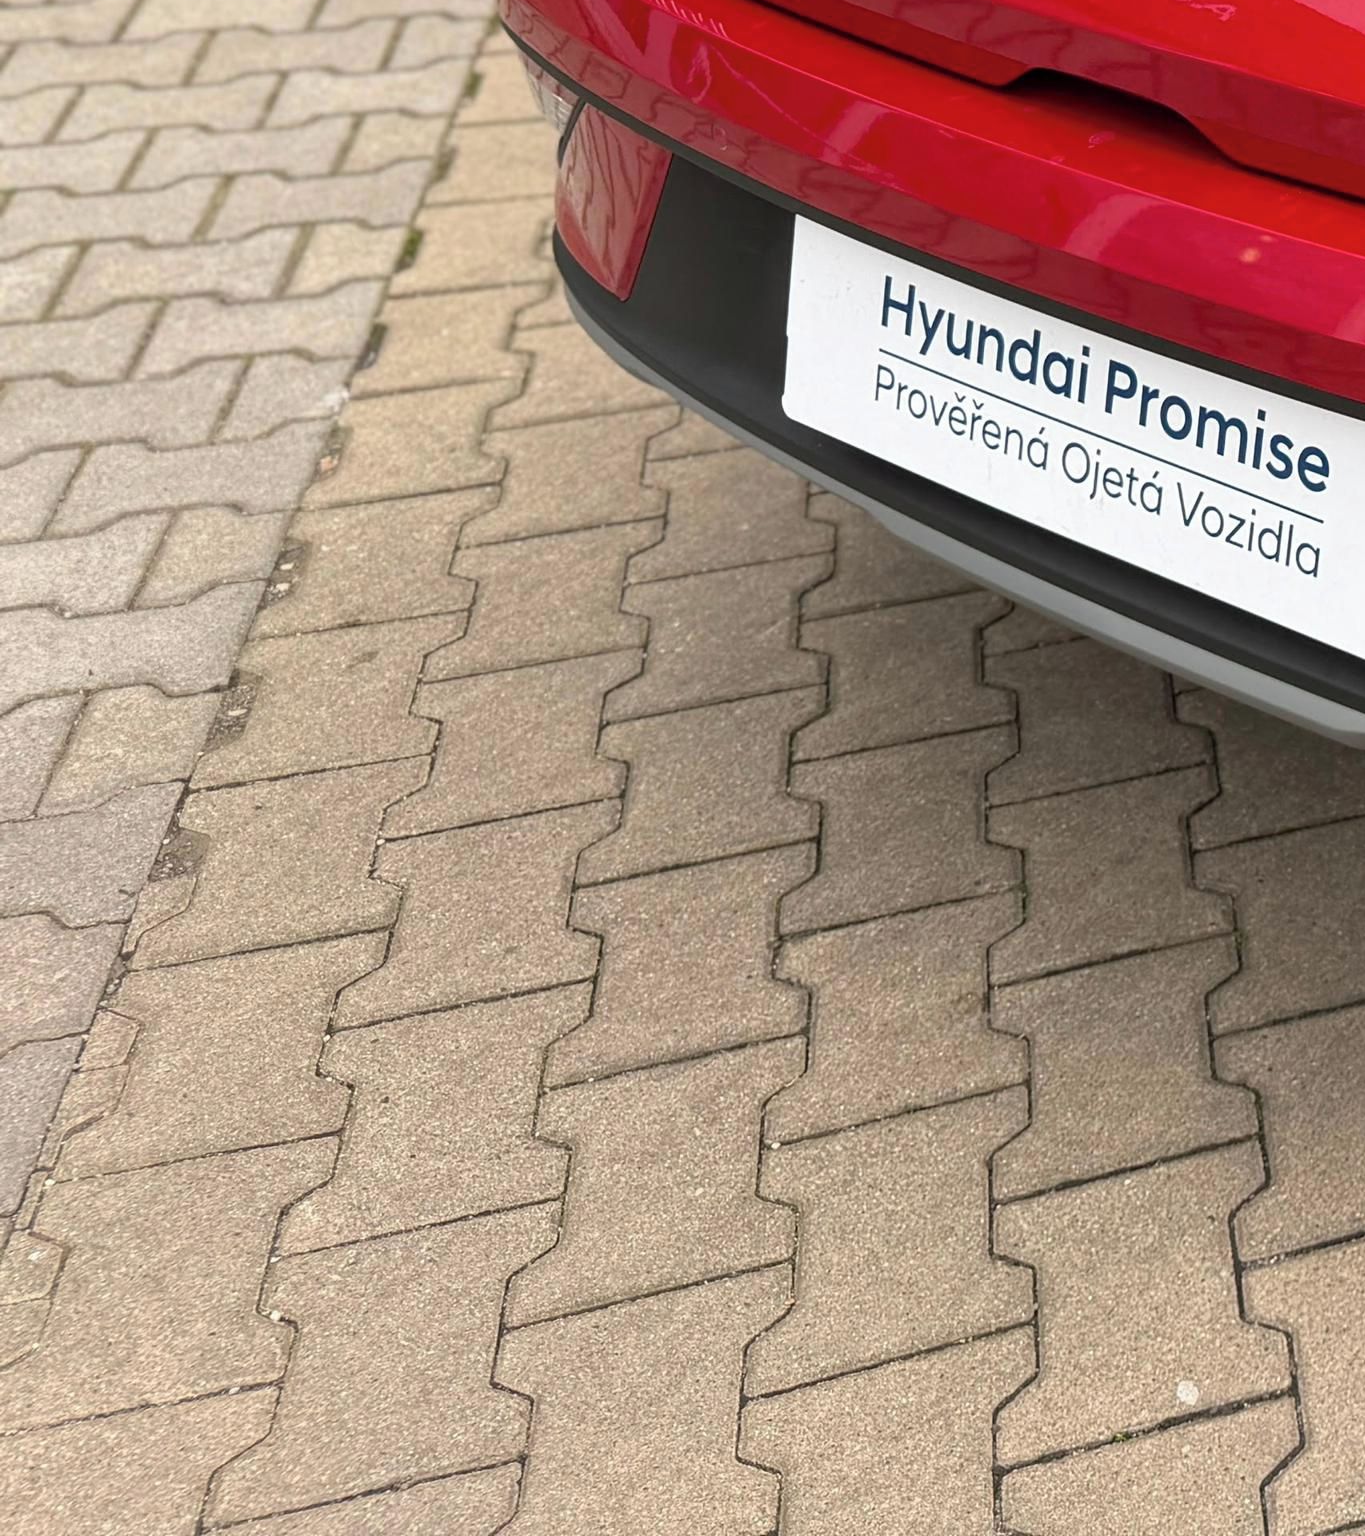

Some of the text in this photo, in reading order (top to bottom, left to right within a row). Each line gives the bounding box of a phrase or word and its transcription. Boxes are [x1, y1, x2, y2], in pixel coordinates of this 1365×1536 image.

[874, 364, 1322, 579] Prověřená Ojetá Vozidla
[879, 274, 1332, 494] Hyundai Promise
